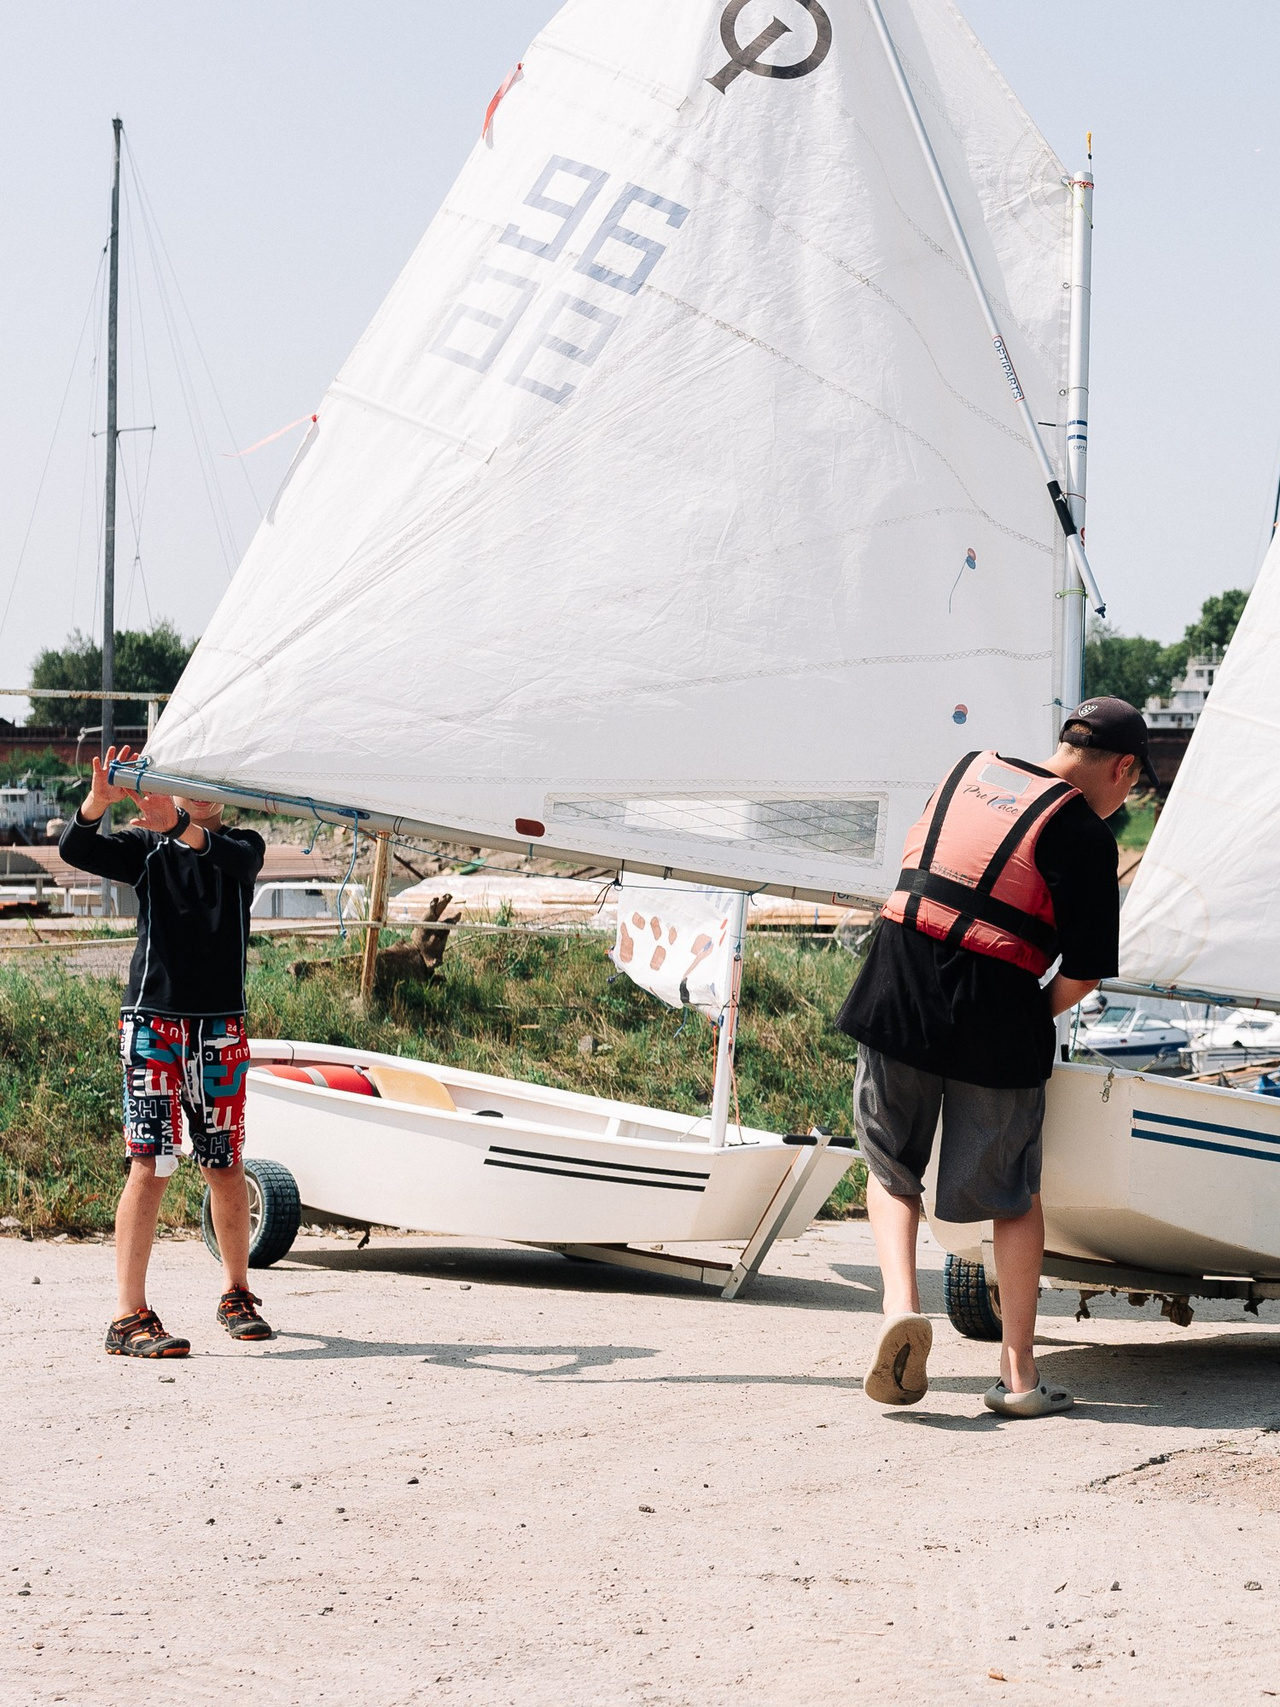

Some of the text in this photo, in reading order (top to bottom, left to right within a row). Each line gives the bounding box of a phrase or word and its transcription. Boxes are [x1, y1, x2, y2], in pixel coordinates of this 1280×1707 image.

[498, 154, 691, 297] 96
[993, 339, 1022, 399] OPTIPARTS
[963, 784, 988, 800] Pro
